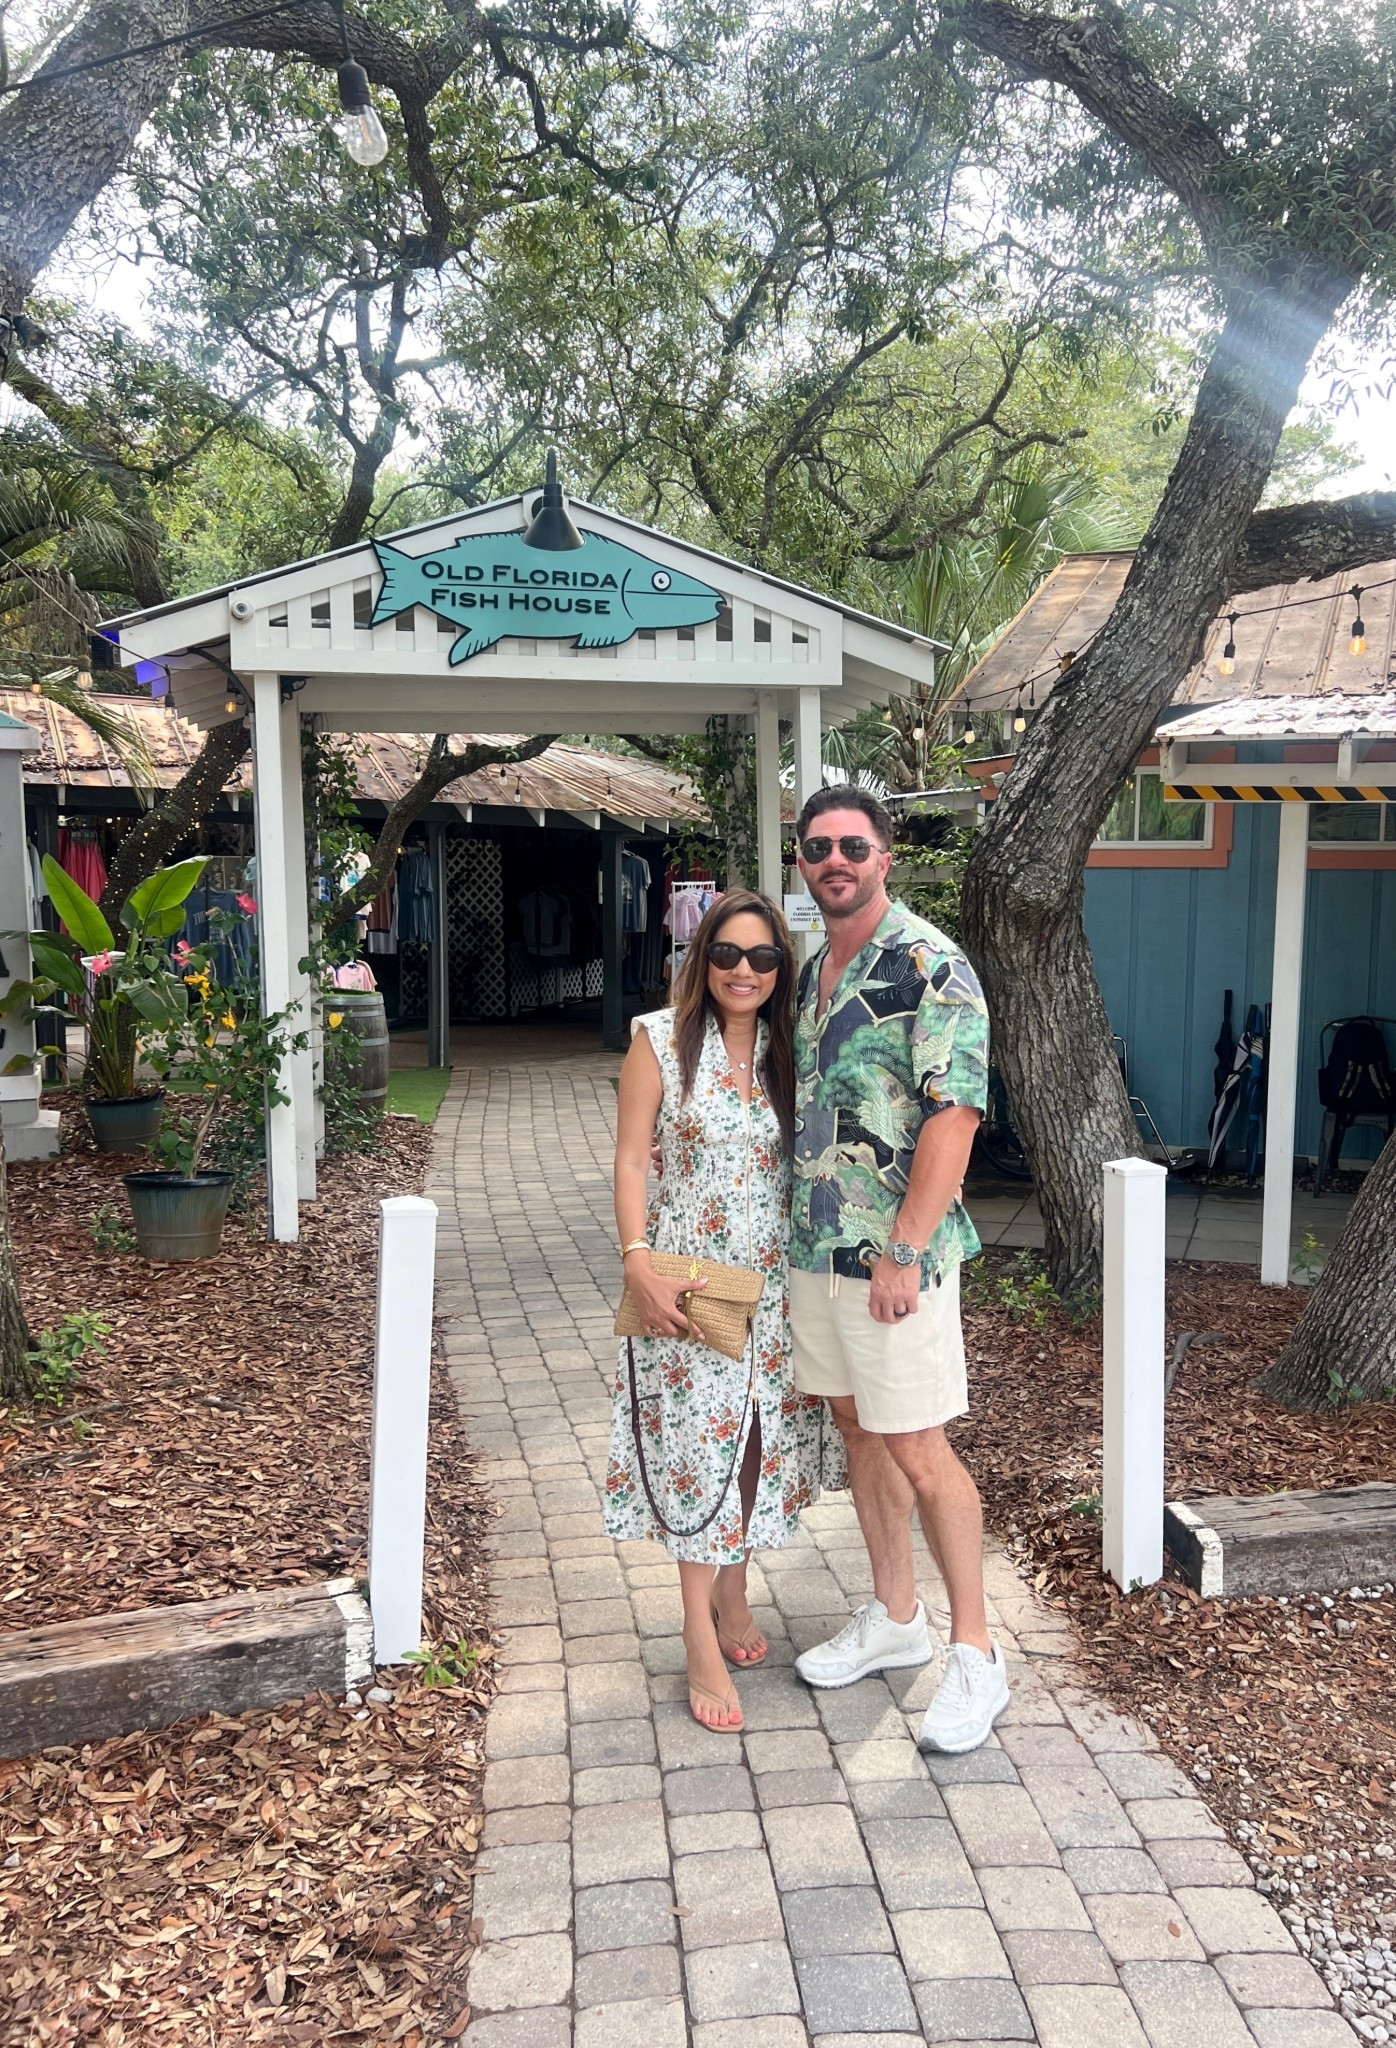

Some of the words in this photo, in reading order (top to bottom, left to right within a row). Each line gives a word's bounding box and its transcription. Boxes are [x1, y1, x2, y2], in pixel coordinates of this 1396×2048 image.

[421, 560, 485, 583] OLD
[492, 564, 619, 589] FLORIDA
[431, 588, 499, 610] FISH
[508, 593, 611, 615] HOUSE
